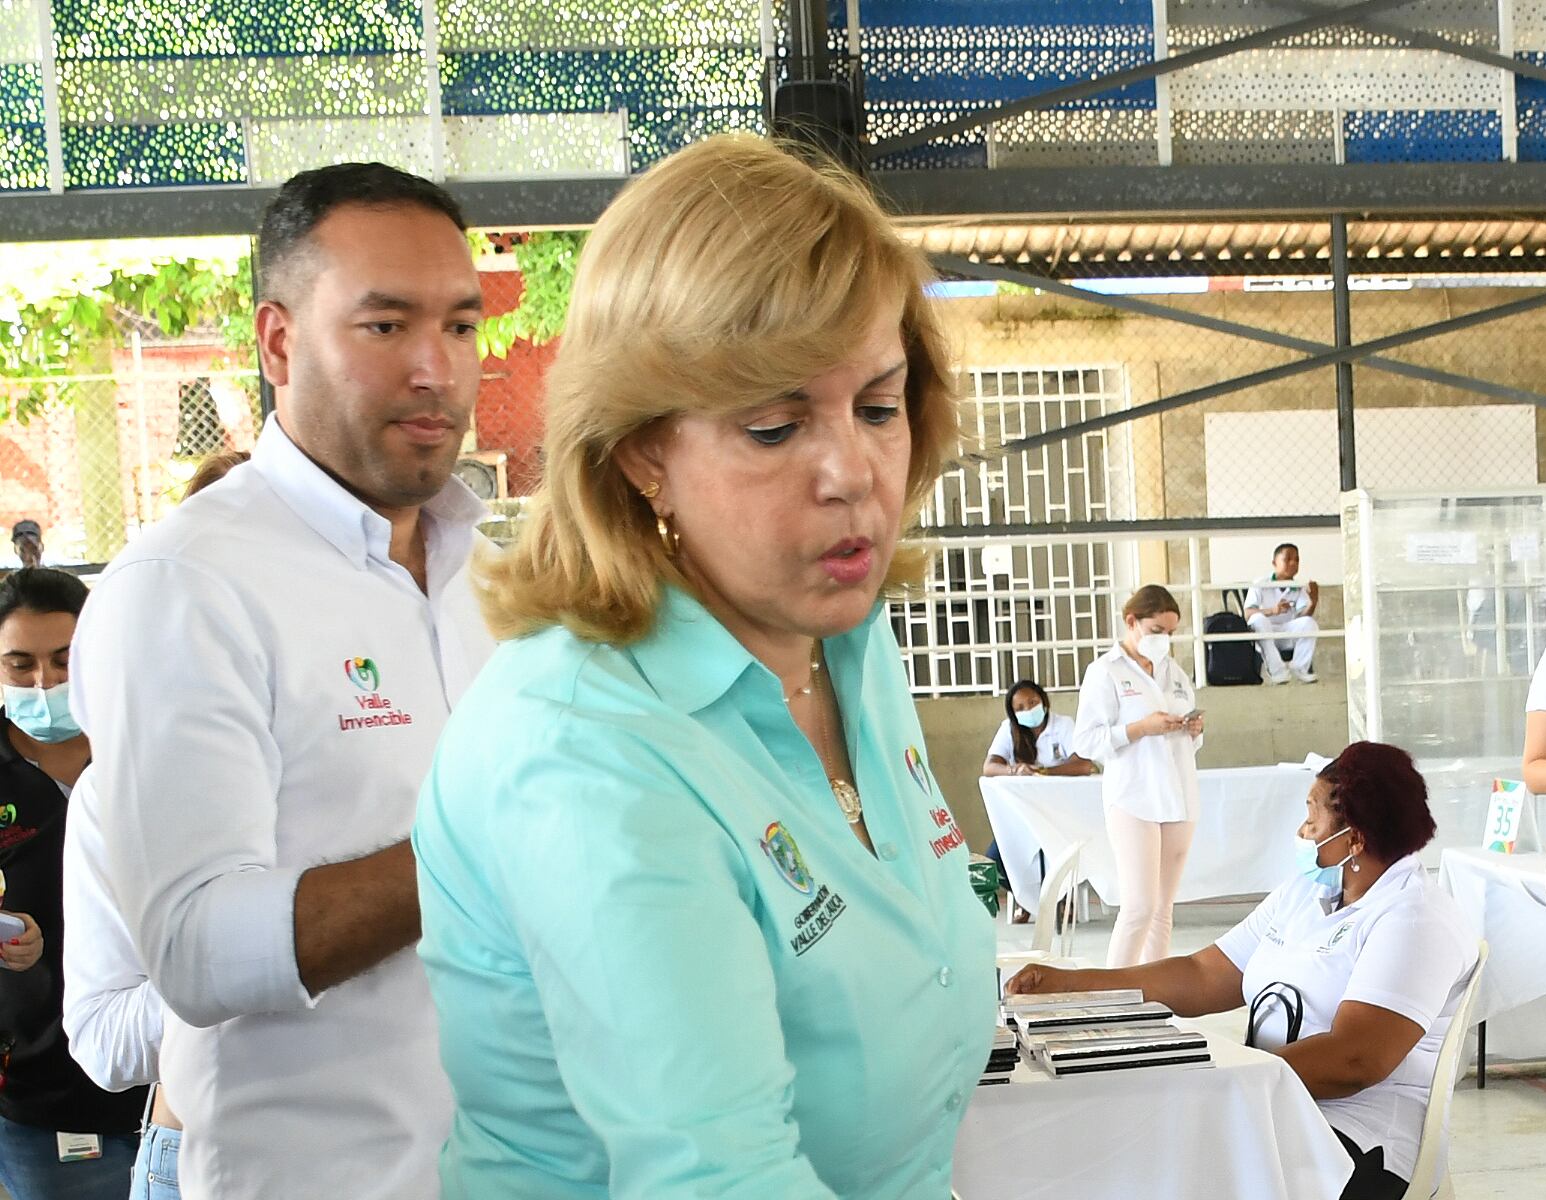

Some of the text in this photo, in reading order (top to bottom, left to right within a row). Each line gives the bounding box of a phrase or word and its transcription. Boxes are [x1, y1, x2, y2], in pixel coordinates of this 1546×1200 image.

[355, 693, 392, 709] Valle
[338, 709, 412, 731] Invencible
[1494, 805, 1513, 836] 35
